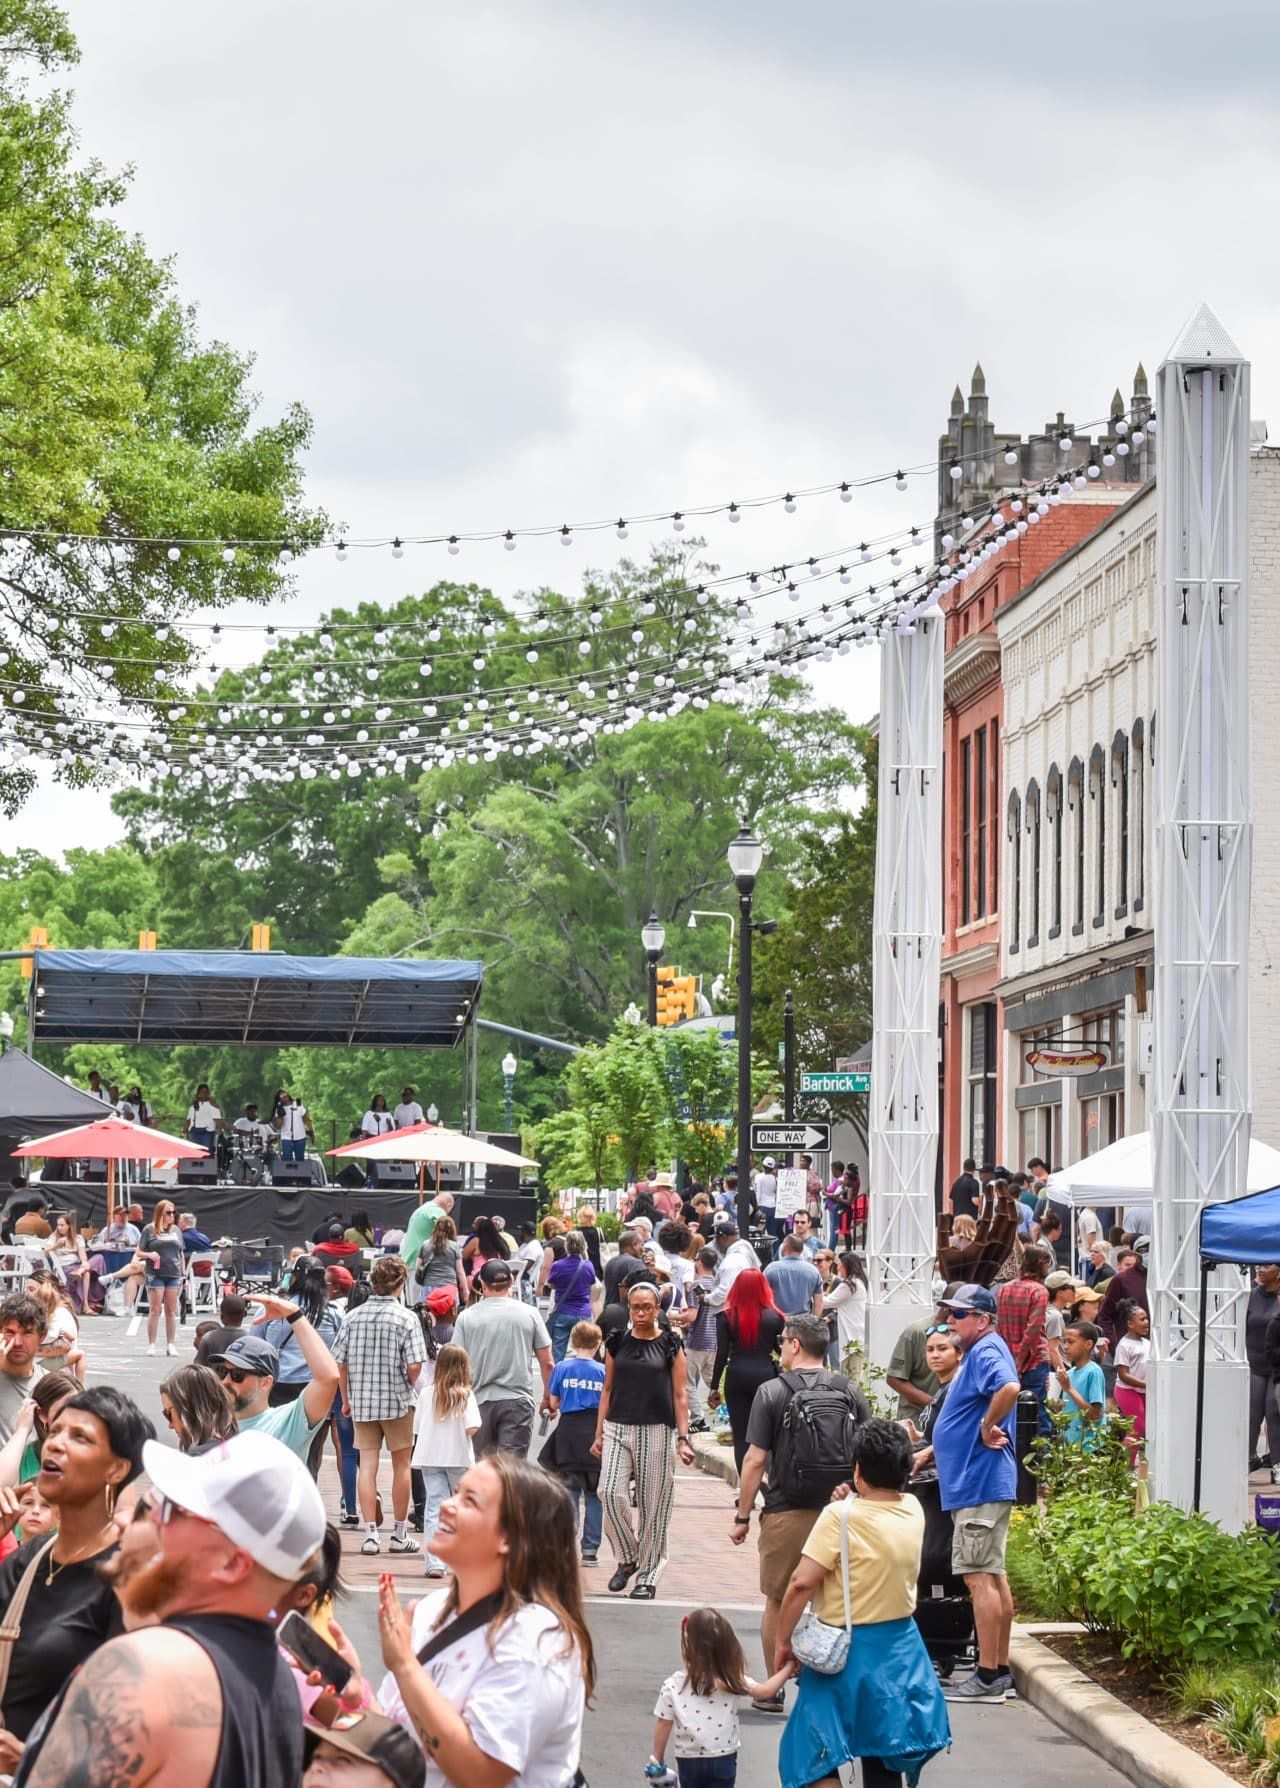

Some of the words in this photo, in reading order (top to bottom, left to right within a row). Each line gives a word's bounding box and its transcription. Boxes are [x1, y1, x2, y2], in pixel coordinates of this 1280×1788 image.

[802, 1075, 854, 1091] Barbrick
[759, 1132, 780, 1143] ONE
[784, 1132, 806, 1143] WAY
